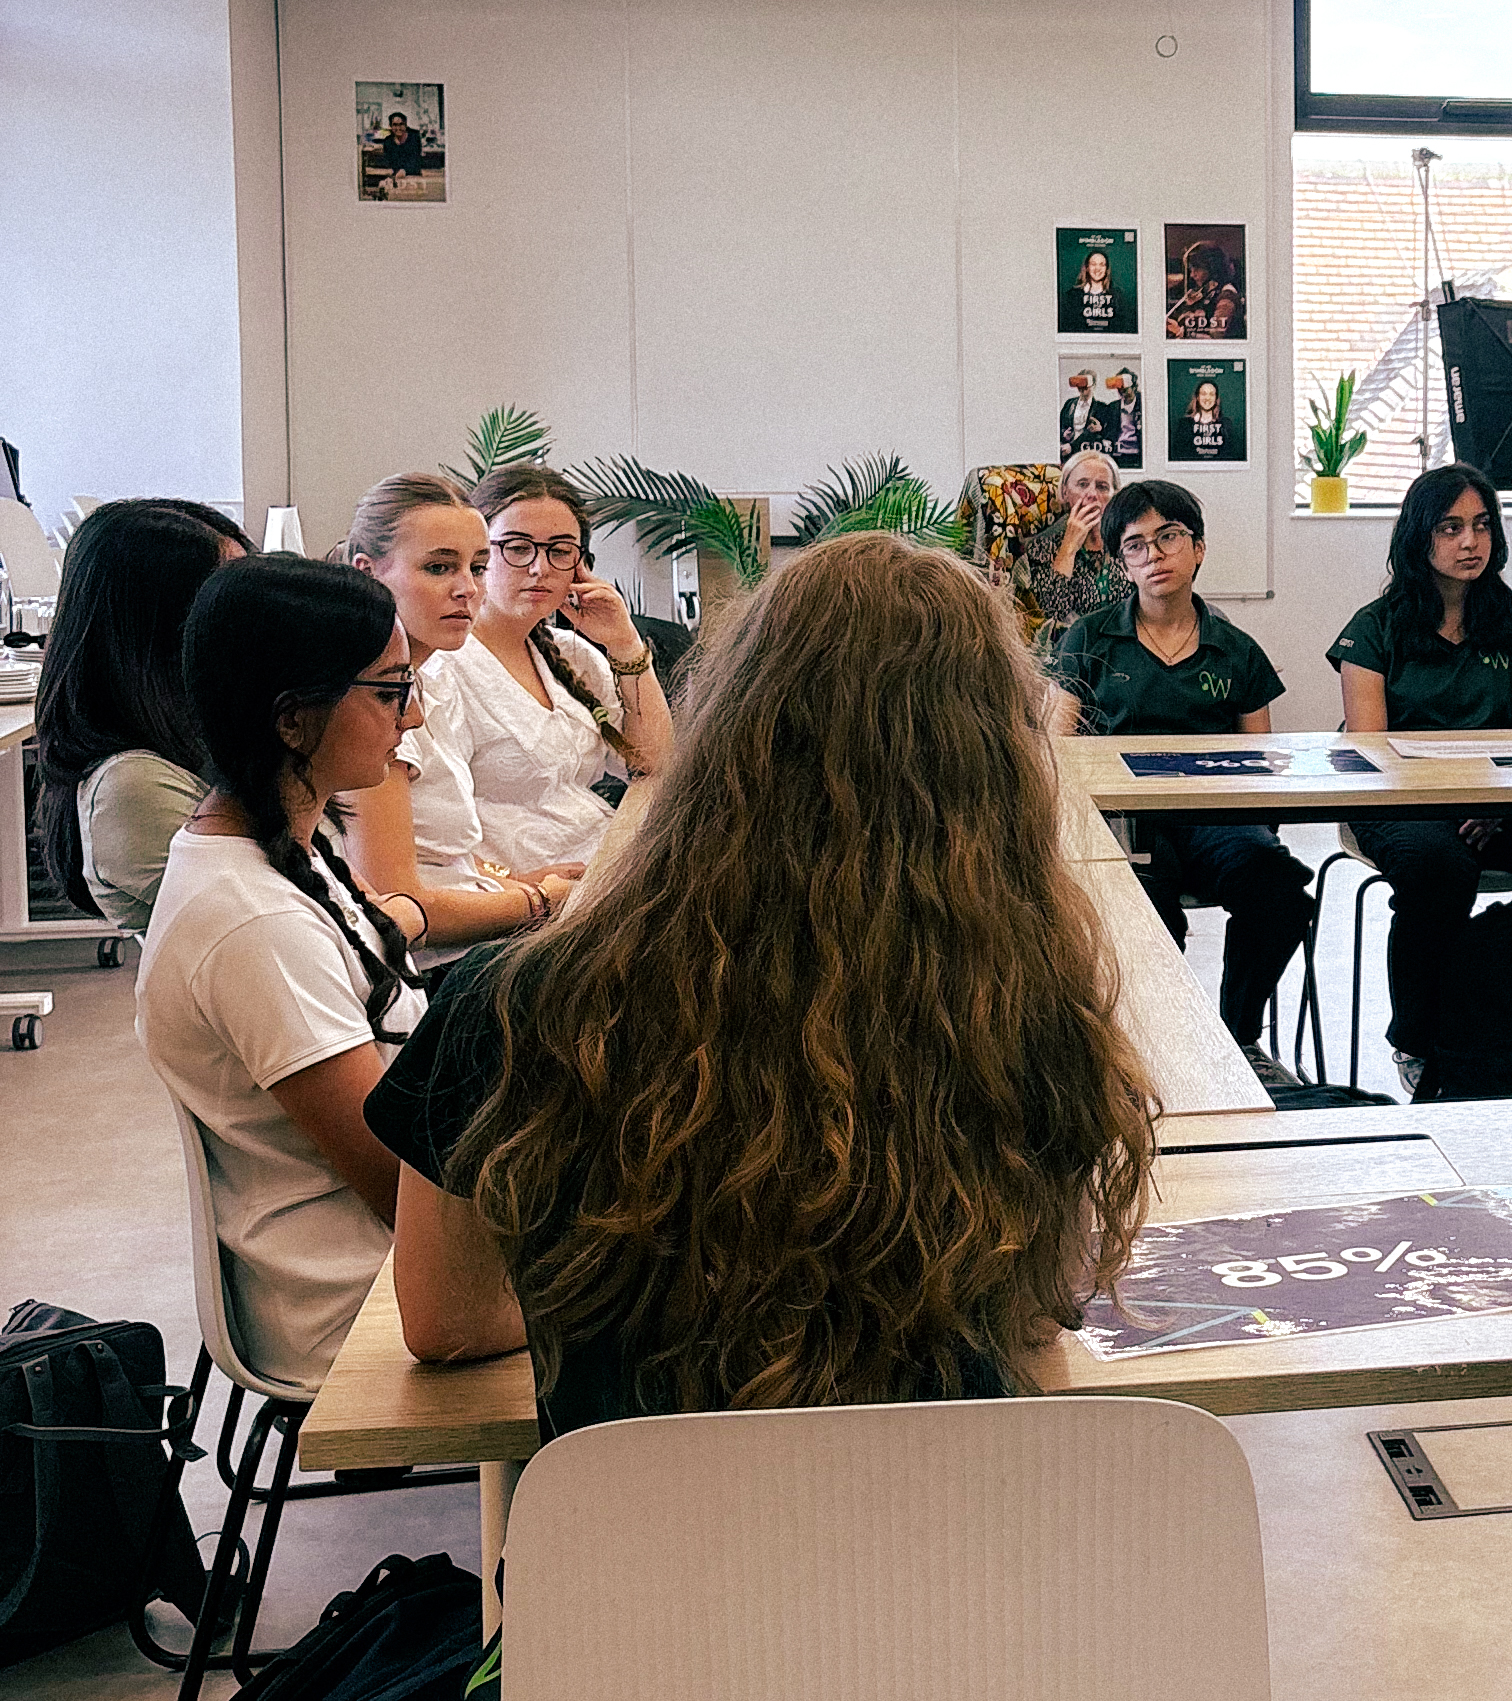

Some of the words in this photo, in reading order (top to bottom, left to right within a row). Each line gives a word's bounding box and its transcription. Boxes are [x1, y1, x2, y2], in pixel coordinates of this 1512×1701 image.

[1083, 294, 1112, 305] FIRST
[1083, 306, 1114, 317] GIRLS
[1184, 316, 1228, 328] GDST
[1193, 423, 1222, 433] FIRST
[1193, 435, 1223, 446] GIRLS
[1211, 1240, 1448, 1288] 85%
